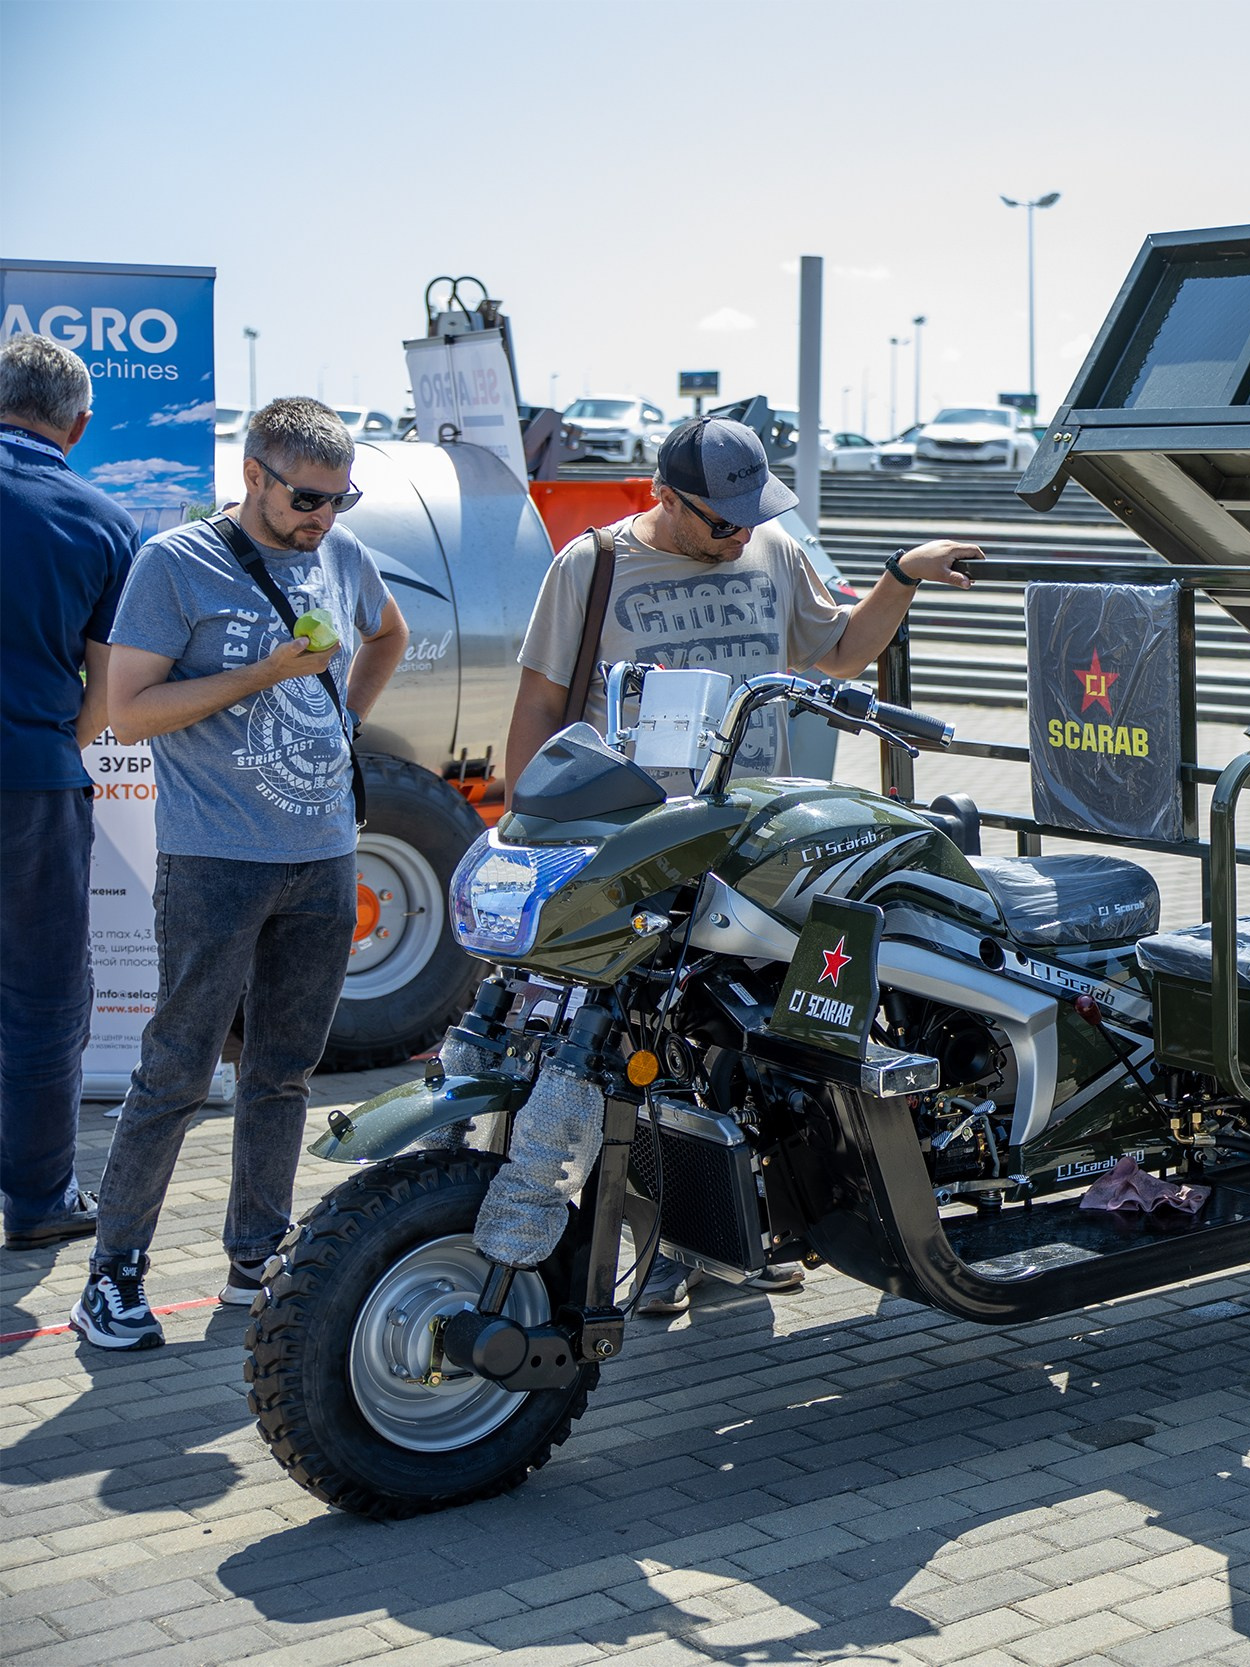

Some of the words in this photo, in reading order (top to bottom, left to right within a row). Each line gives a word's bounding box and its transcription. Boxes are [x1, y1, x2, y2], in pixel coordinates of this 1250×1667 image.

[0, 304, 178, 354] AGRO
[286, 739, 314, 756] FAST
[1048, 718, 1149, 758] SCARAB
[255, 782, 302, 815] DEFINED
[306, 805, 319, 816] BY
[801, 846, 822, 862] CJ
[825, 831, 876, 856] Scarab
[1098, 906, 1109, 916] CJ
[1114, 900, 1145, 914] Scarab
[133, 929, 151, 940] 4,3
[1057, 971, 1115, 1006] Scarab
[789, 990, 806, 1012] CJ
[806, 995, 854, 1027] SCARAB
[1058, 1164, 1072, 1178] CJ
[1075, 1156, 1118, 1174] Scarab
